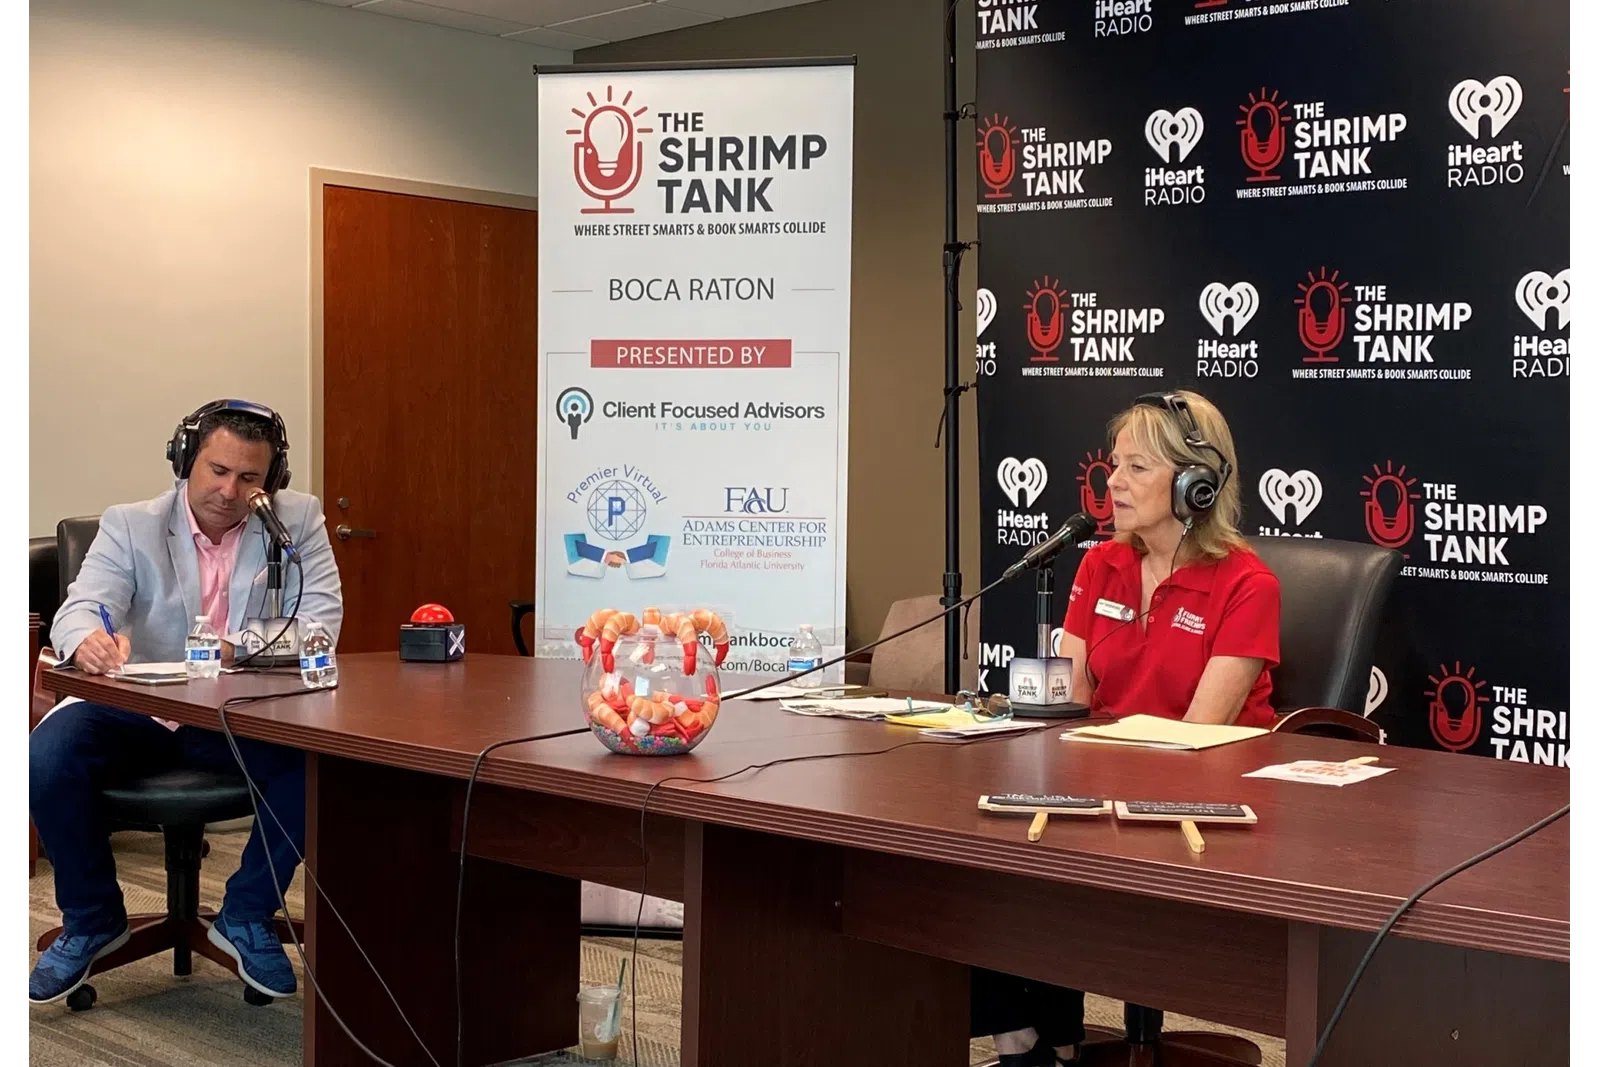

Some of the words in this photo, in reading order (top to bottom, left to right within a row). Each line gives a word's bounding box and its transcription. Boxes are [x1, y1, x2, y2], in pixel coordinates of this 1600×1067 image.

[1096, 0, 1152, 18] iHeart
[1185, 14, 1208, 25] WHERE
[1209, 10, 1233, 22] STREET
[1234, 6, 1262, 19] SMARTS
[1262, 6, 1268, 15] &
[1270, 4, 1289, 14] BOOK
[1290, 0, 1319, 12] SMARTS
[978, 5, 1038, 34] TANK
[1095, 14, 1152, 38] RADIO
[976, 39, 995, 49] MARTS
[1002, 37, 1017, 47] BOOK
[1018, 35, 1041, 45] SMARTS
[1042, 32, 1066, 42] COLLIDE
[1294, 102, 1324, 119] THE
[658, 112, 704, 132] THE
[1294, 113, 1407, 148] SHRIMP
[1021, 128, 1046, 142] THE
[658, 134, 827, 173] SHRIMP
[1022, 139, 1112, 169] SHRIMP
[1294, 146, 1372, 179] TANK
[1448, 140, 1522, 167] iHeart
[1022, 169, 1084, 196] TANK
[1145, 166, 1204, 187] iHeart
[1448, 162, 1523, 188] RADIO
[658, 177, 774, 213] TANK
[1145, 185, 1205, 206] RADIO
[1236, 188, 1261, 198] WHERE
[1262, 186, 1287, 197] STREET
[1288, 184, 1316, 196] SMARTS
[1317, 184, 1323, 193] &
[1325, 183, 1345, 193] BOOK
[1346, 180, 1375, 192] SMARTS
[1376, 178, 1407, 189] COLLIDE
[976, 204, 996, 213] WHERE
[997, 203, 1017, 212] STREET
[1018, 202, 1040, 212] SMARTS
[1041, 202, 1046, 210] &
[1046, 201, 1063, 210] BOOK
[1064, 199, 1088, 209] SMARTS
[1088, 197, 1113, 207] COLLIDE
[574, 224, 610, 236] WHERE
[613, 224, 650, 236] STREET
[652, 223, 694, 235] SMARTS
[697, 223, 705, 235] &
[708, 223, 736, 235] BOOK
[739, 222, 780, 234] SMARTS
[783, 221, 826, 234] COLLIDE
[609, 278, 681, 301] BOCA
[690, 278, 774, 300] RATON
[1354, 286, 1386, 301] THE
[1071, 293, 1097, 308] THE
[1071, 308, 1165, 334] SHRIMP
[1354, 302, 1472, 332] SHRIMP
[617, 347, 734, 365] PRESENTED
[741, 347, 766, 364] BY
[1070, 337, 1134, 362] TANK
[1198, 339, 1258, 359] iHeart
[1353, 334, 1434, 362] TANK
[1022, 367, 1042, 376] WHERE
[1043, 367, 1064, 376] STREET
[1065, 367, 1088, 376] SMARTS
[1089, 368, 1094, 376] &
[1095, 368, 1112, 376] BOOK
[1112, 368, 1137, 376] SMARTS
[1138, 368, 1164, 377] COLLIDE
[1197, 360, 1258, 378] RADIO
[1292, 369, 1318, 378] WHERE
[1319, 369, 1345, 378] STREET
[1346, 369, 1376, 379] SMARTS
[1377, 369, 1383, 379] &
[1384, 369, 1406, 379] BOOK
[1407, 369, 1438, 379] SMARTS
[1439, 369, 1471, 380] COLLIDE
[602, 402, 656, 419] Client
[661, 401, 739, 418] Focused
[744, 402, 825, 419] Advisors
[690, 423, 736, 431] ABOUT
[567, 466, 618, 504] Premier
[624, 464, 667, 504] Virtual
[1423, 482, 1456, 500] THE
[724, 487, 789, 514] FAU
[608, 496, 626, 527] P
[998, 509, 1048, 529] iHeart
[1424, 502, 1547, 534] SHRIMP
[682, 520, 735, 532] ADAMS
[739, 520, 795, 533] CENTER
[799, 522, 826, 533] FOR
[683, 533, 826, 547] ENTREPRENEURSHIP
[998, 529, 1049, 546] RADIO
[714, 548, 744, 559] College
[746, 549, 754, 558] of
[757, 550, 791, 558] Business
[1424, 534, 1509, 566] TANK
[700, 560, 728, 569] Florida
[730, 561, 760, 570] Atlantic
[764, 561, 805, 571] University
[1400, 566, 1417, 576] EET
[1418, 567, 1449, 580] SMARTS
[1451, 570, 1457, 580] &
[1458, 570, 1480, 581] BOOK
[1481, 571, 1514, 583] SMARTS
[1515, 573, 1548, 584] COLLIDE
[1493, 686, 1527, 705] THE
[1490, 738, 1575, 768] TANK
